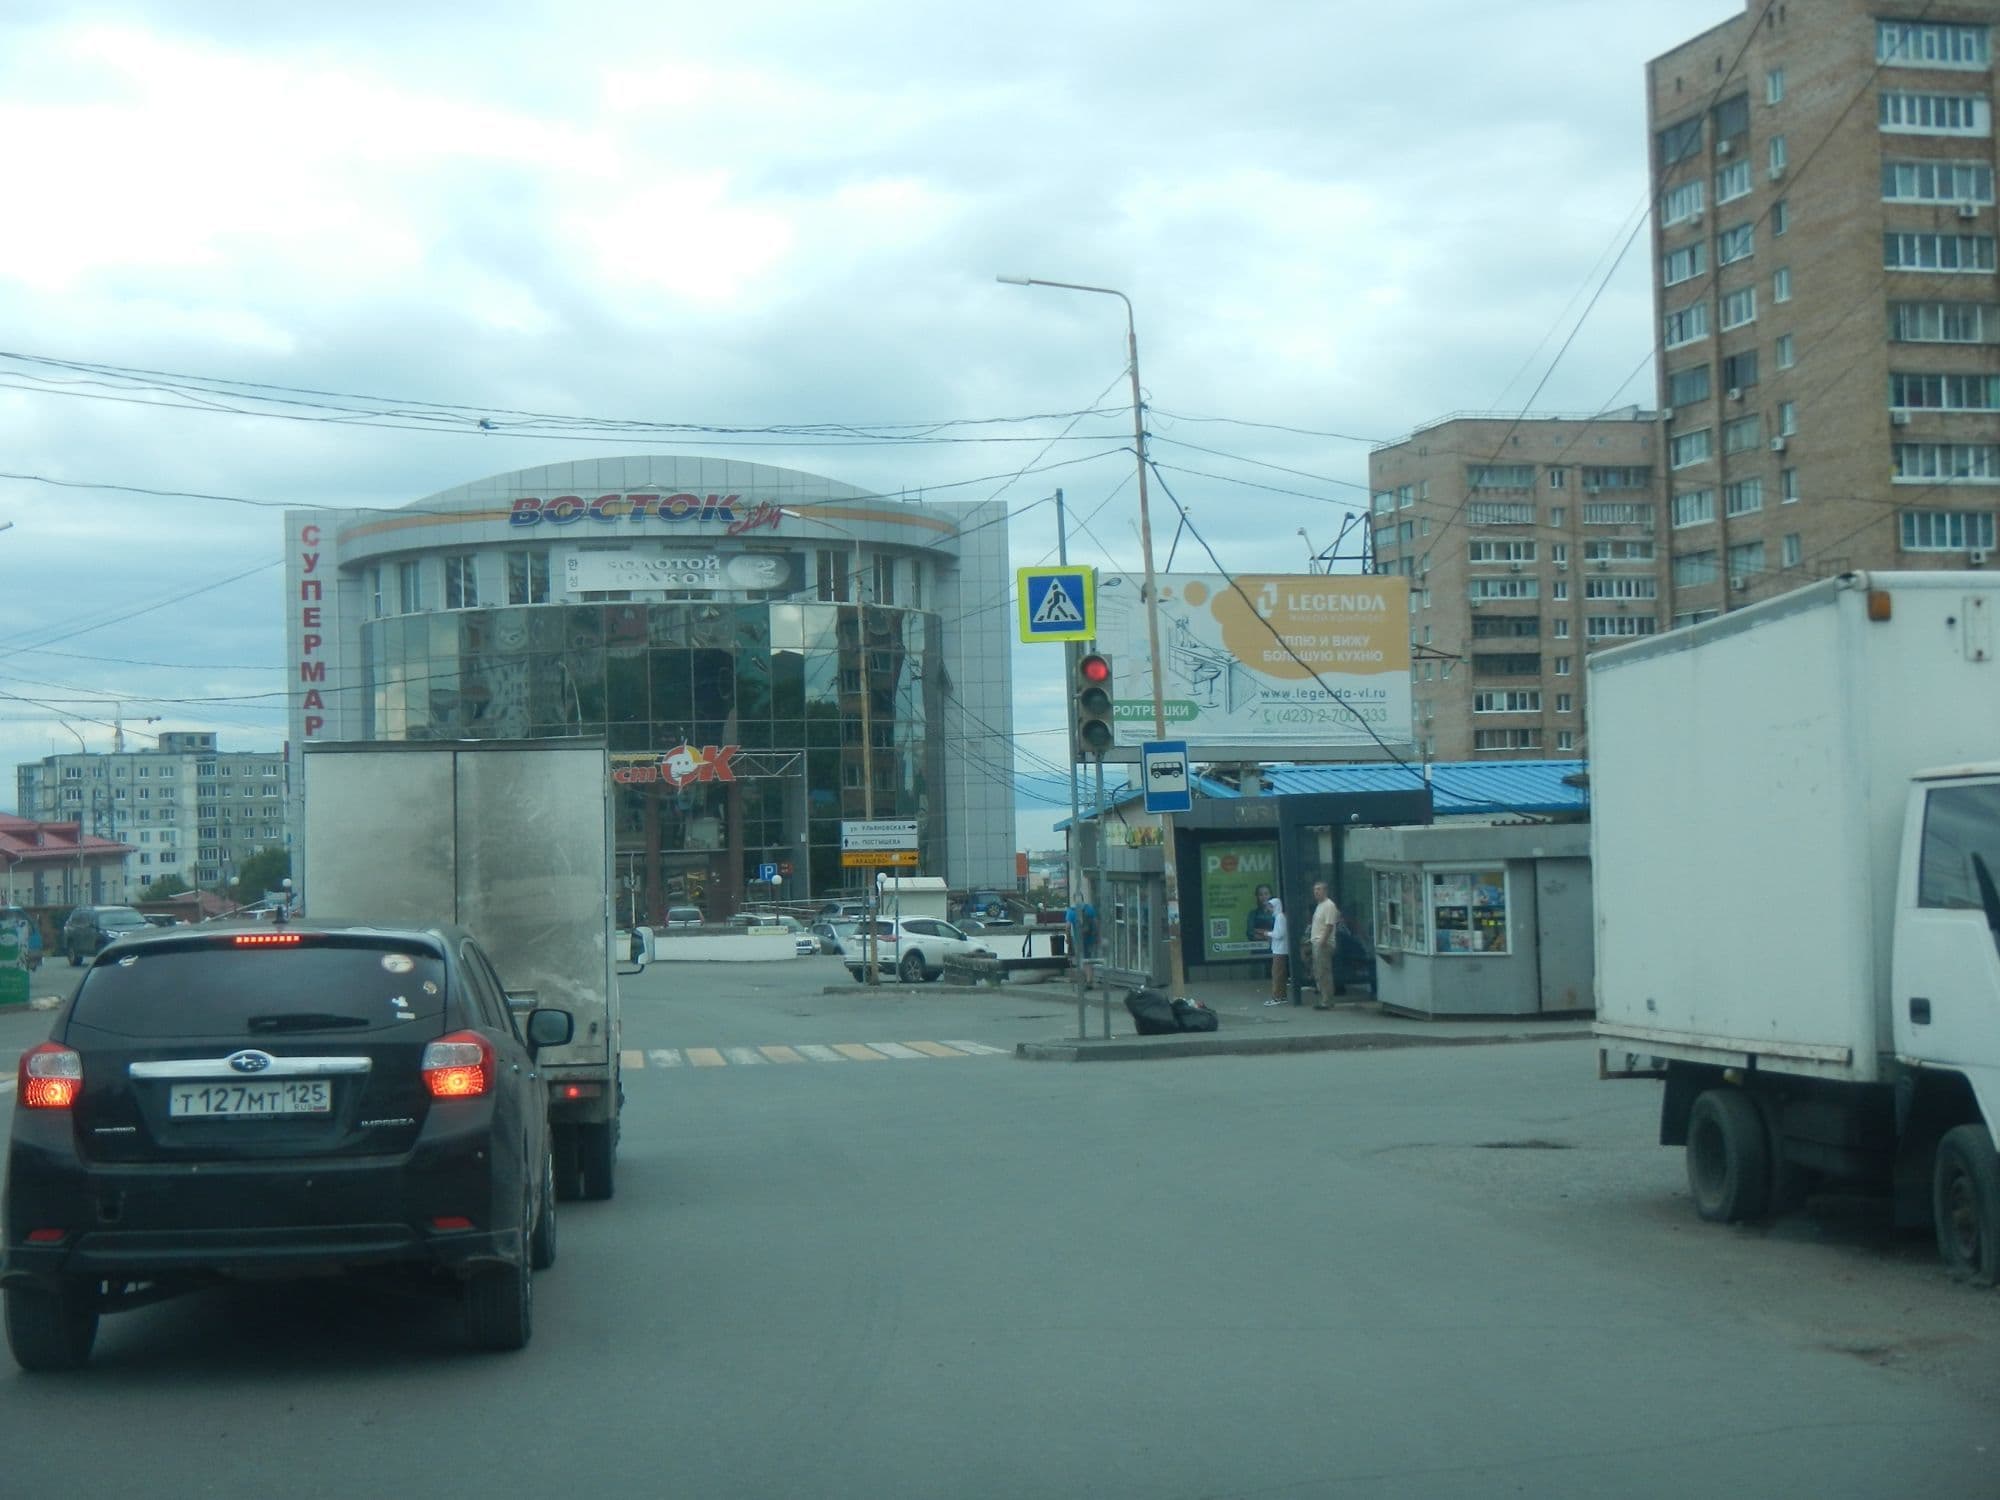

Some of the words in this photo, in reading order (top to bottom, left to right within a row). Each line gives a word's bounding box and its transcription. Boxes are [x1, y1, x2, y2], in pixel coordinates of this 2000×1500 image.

[509, 493, 741, 527] ВОСТОК
[1319, 636, 1329, 647] И
[1332, 635, 1370, 647] ВИЖУ
[1337, 650, 1384, 662] КУХНЮ
[1277, 708, 1315, 724] (423)
[1318, 708, 1387, 722] 2-700333
[286, 1082, 325, 1104] 125
